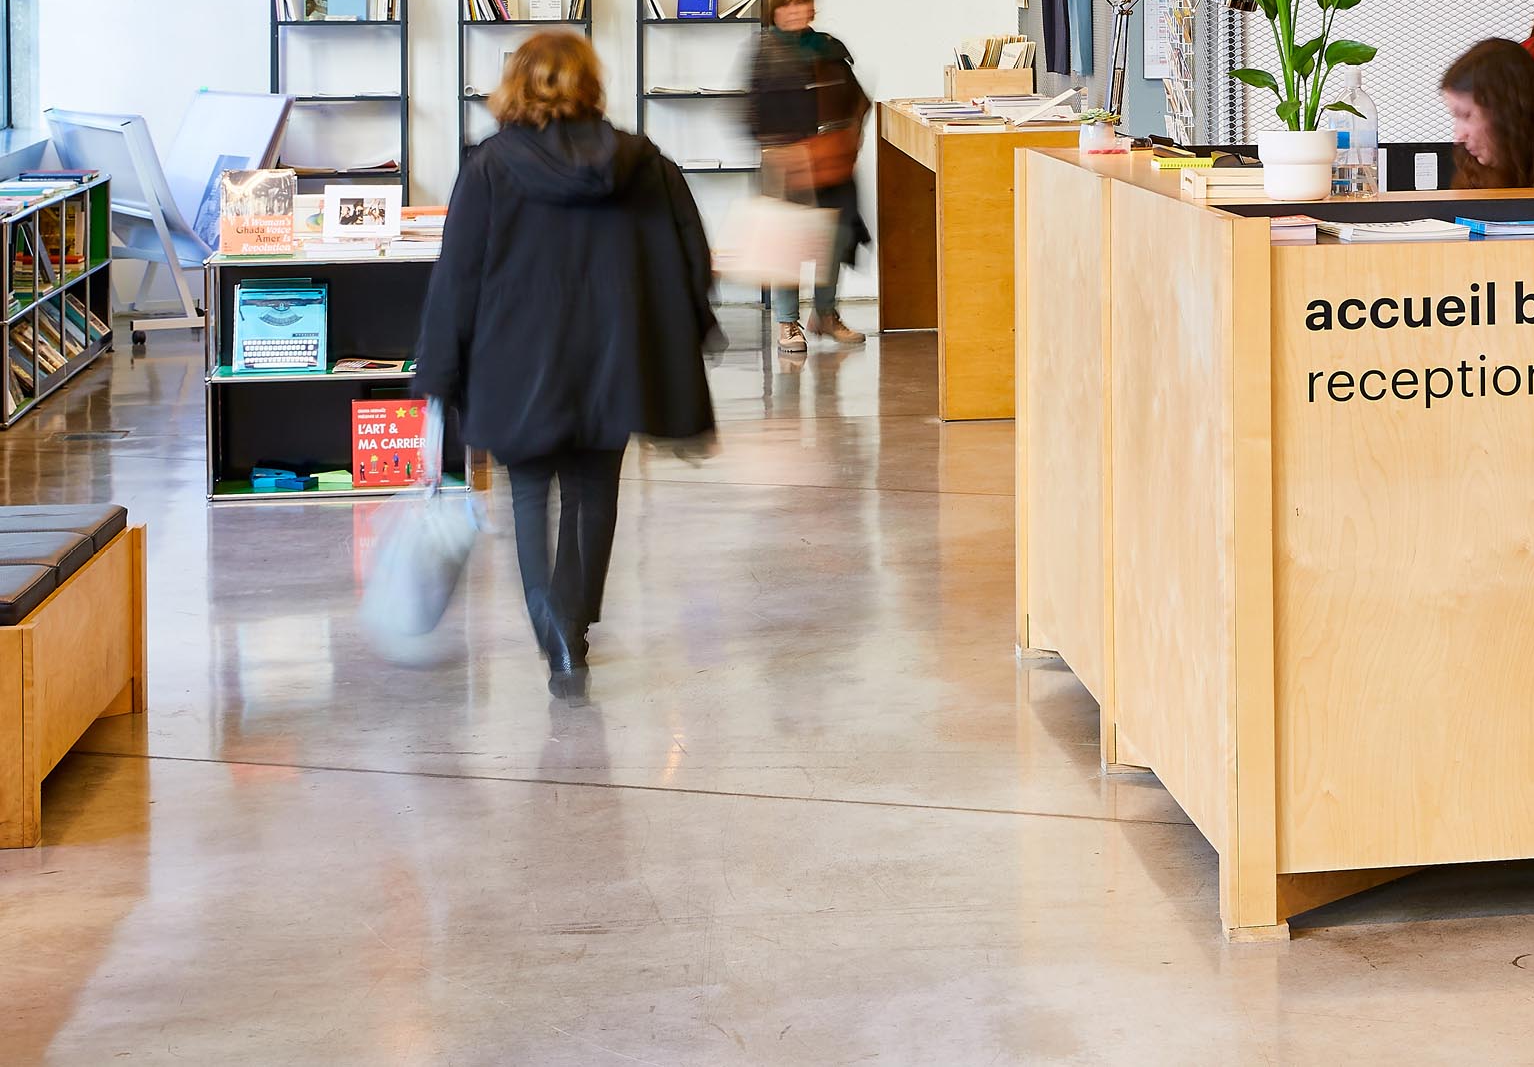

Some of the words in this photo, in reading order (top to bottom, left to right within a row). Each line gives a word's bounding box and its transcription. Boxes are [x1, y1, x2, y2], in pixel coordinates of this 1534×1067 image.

[1306, 282, 1497, 332] accueil
[358, 423, 385, 434] L'ART
[389, 423, 398, 434] &
[358, 439, 378, 450] MA
[381, 435, 426, 449] CARRIÈR
